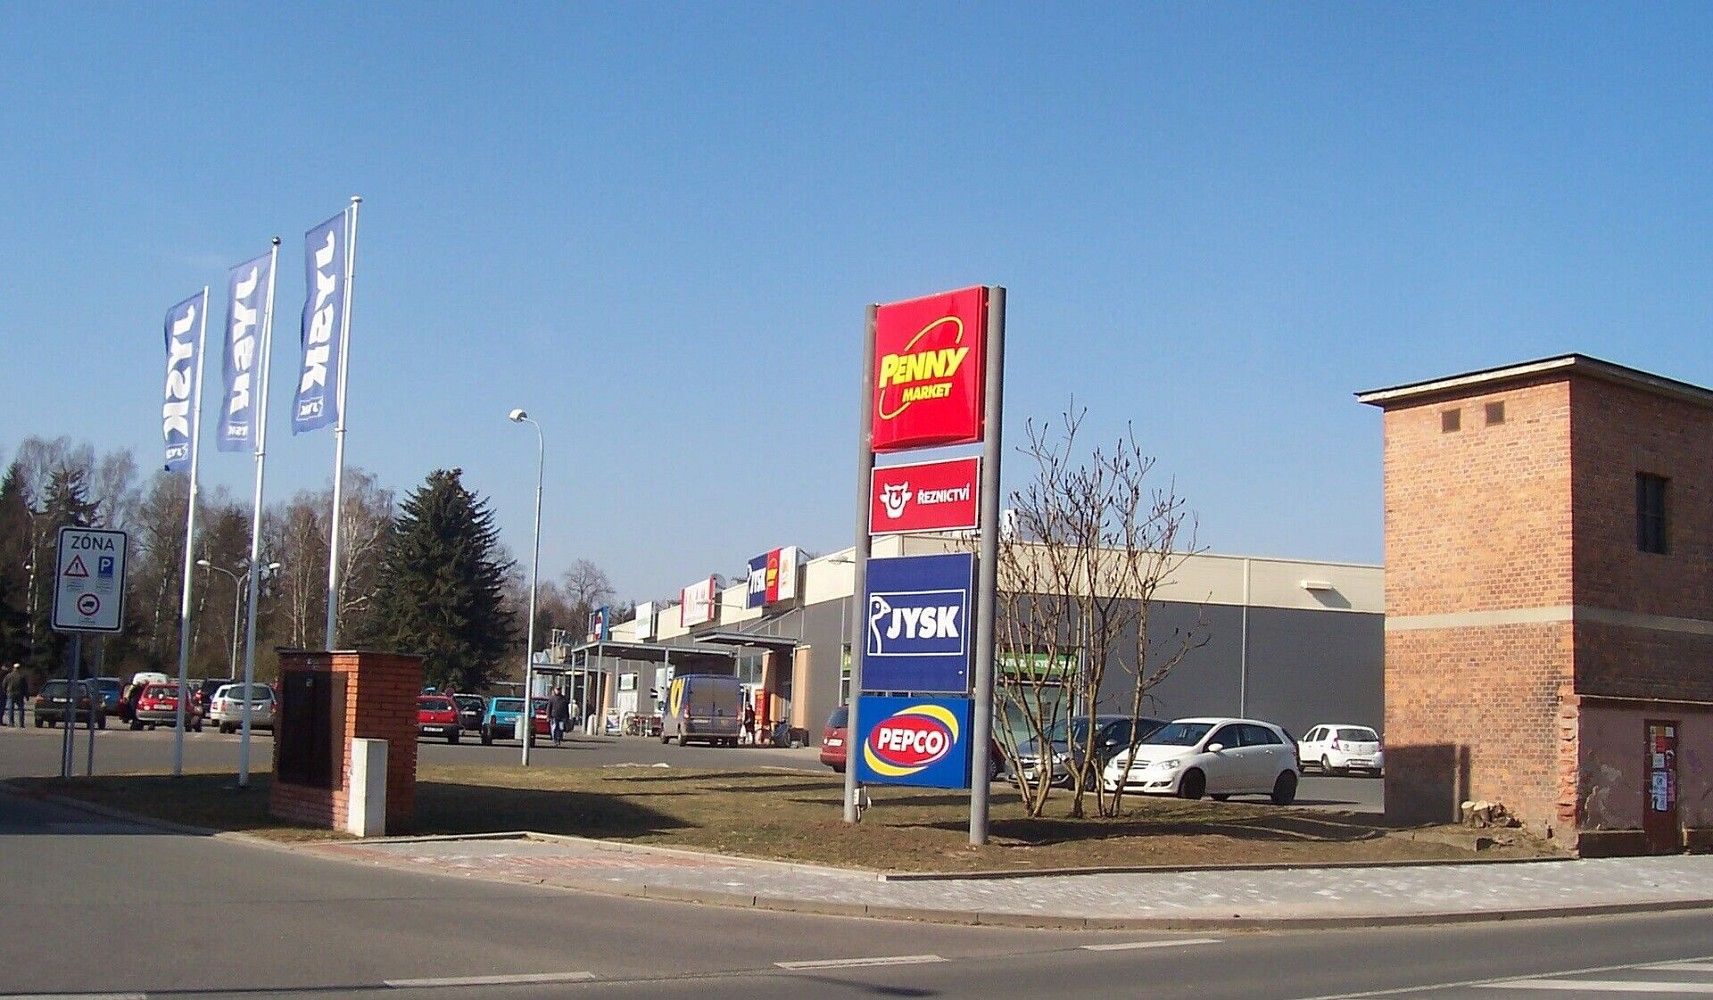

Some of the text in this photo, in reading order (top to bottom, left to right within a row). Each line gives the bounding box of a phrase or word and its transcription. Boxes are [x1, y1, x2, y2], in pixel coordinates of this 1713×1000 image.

[879, 347, 969, 388] PENNY
[902, 383, 953, 403] MARKET
[917, 483, 970, 505] ŘEZNICTVÍ
[71, 533, 114, 551] ZÓNA
[101, 558, 111, 572] P
[886, 606, 959, 639] JYSK
[878, 728, 945, 755] PEPCO
